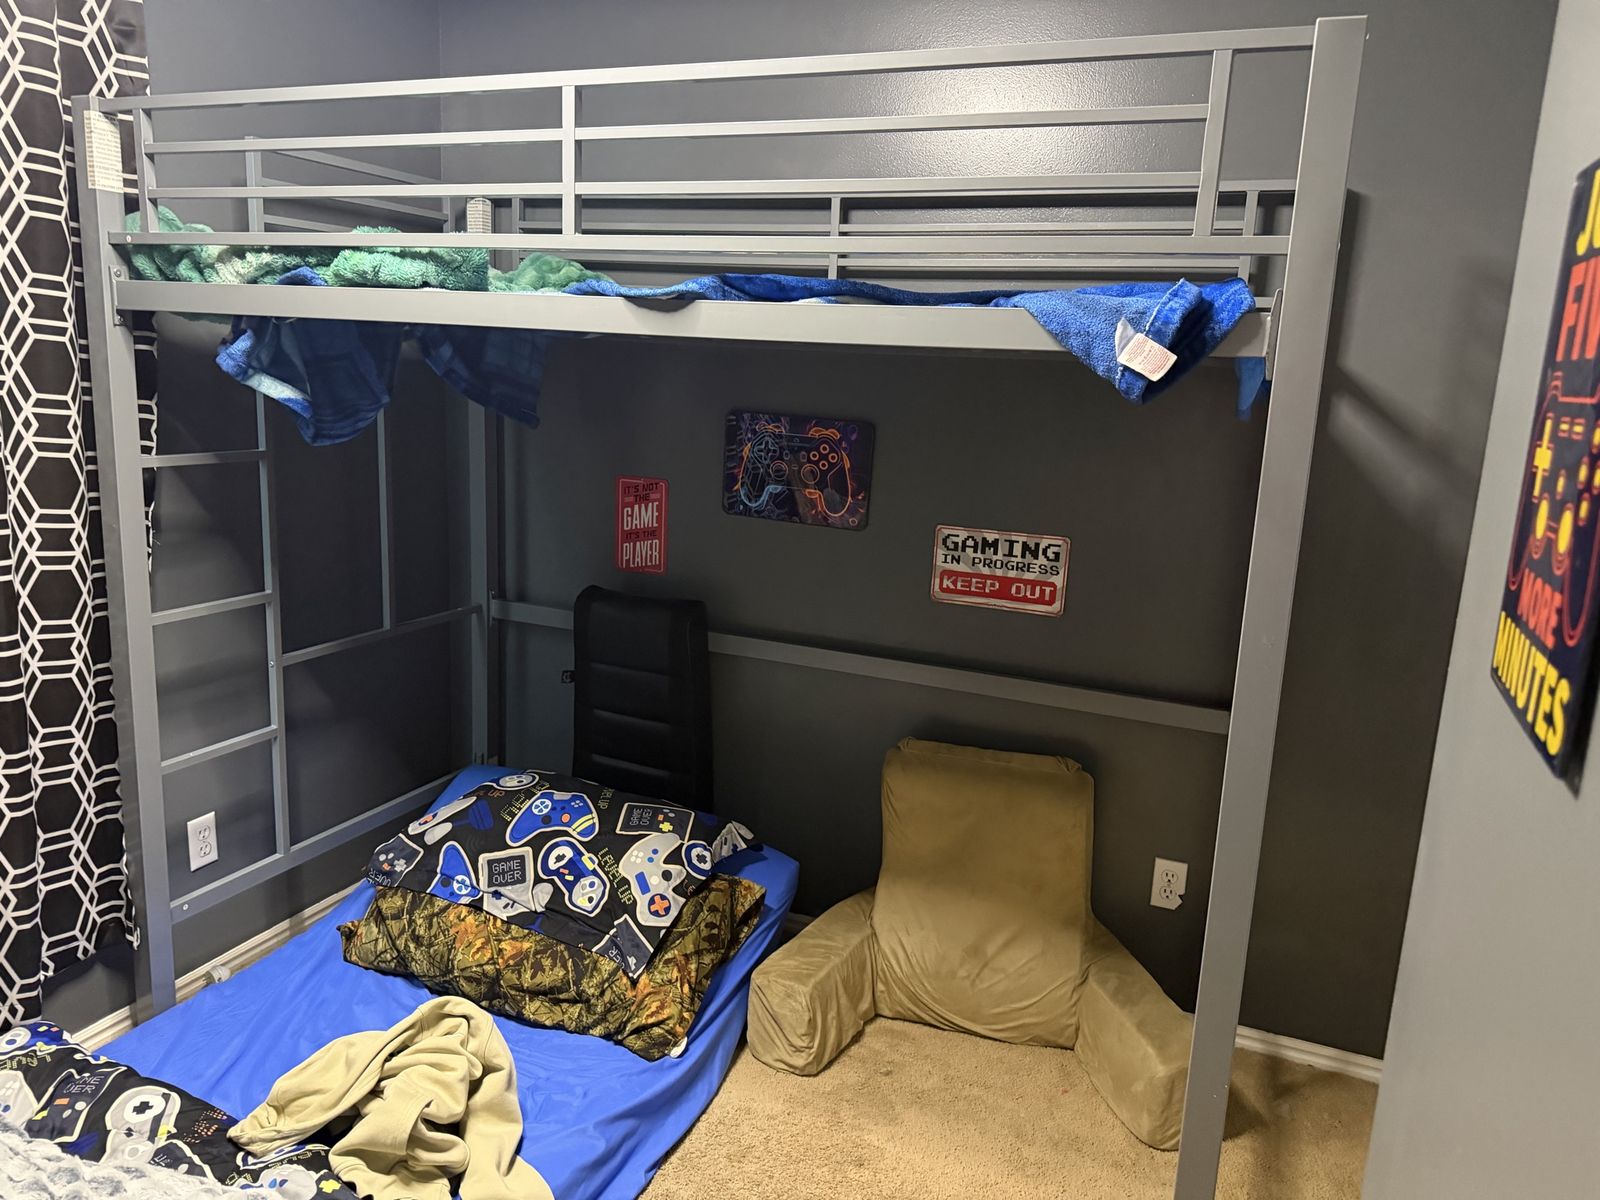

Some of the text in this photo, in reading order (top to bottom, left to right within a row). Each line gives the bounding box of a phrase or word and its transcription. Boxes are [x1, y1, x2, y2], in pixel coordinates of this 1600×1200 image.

[624, 482, 659, 495] IT'S NOT
[633, 493, 650, 502] THE
[623, 502, 659, 531] GAME
[625, 530, 657, 540] IT'S THE
[623, 539, 659, 568] PLAYER
[942, 533, 1061, 562] GAMING
[941, 553, 1060, 576] IN PROGRESS
[942, 575, 1054, 601] KEEP OUT
[1517, 567, 1563, 649] MORE
[1493, 611, 1571, 756] MINUTES
[492, 860, 521, 873] GAME
[492, 870, 522, 884] OVER
[617, 884, 634, 904] UP
